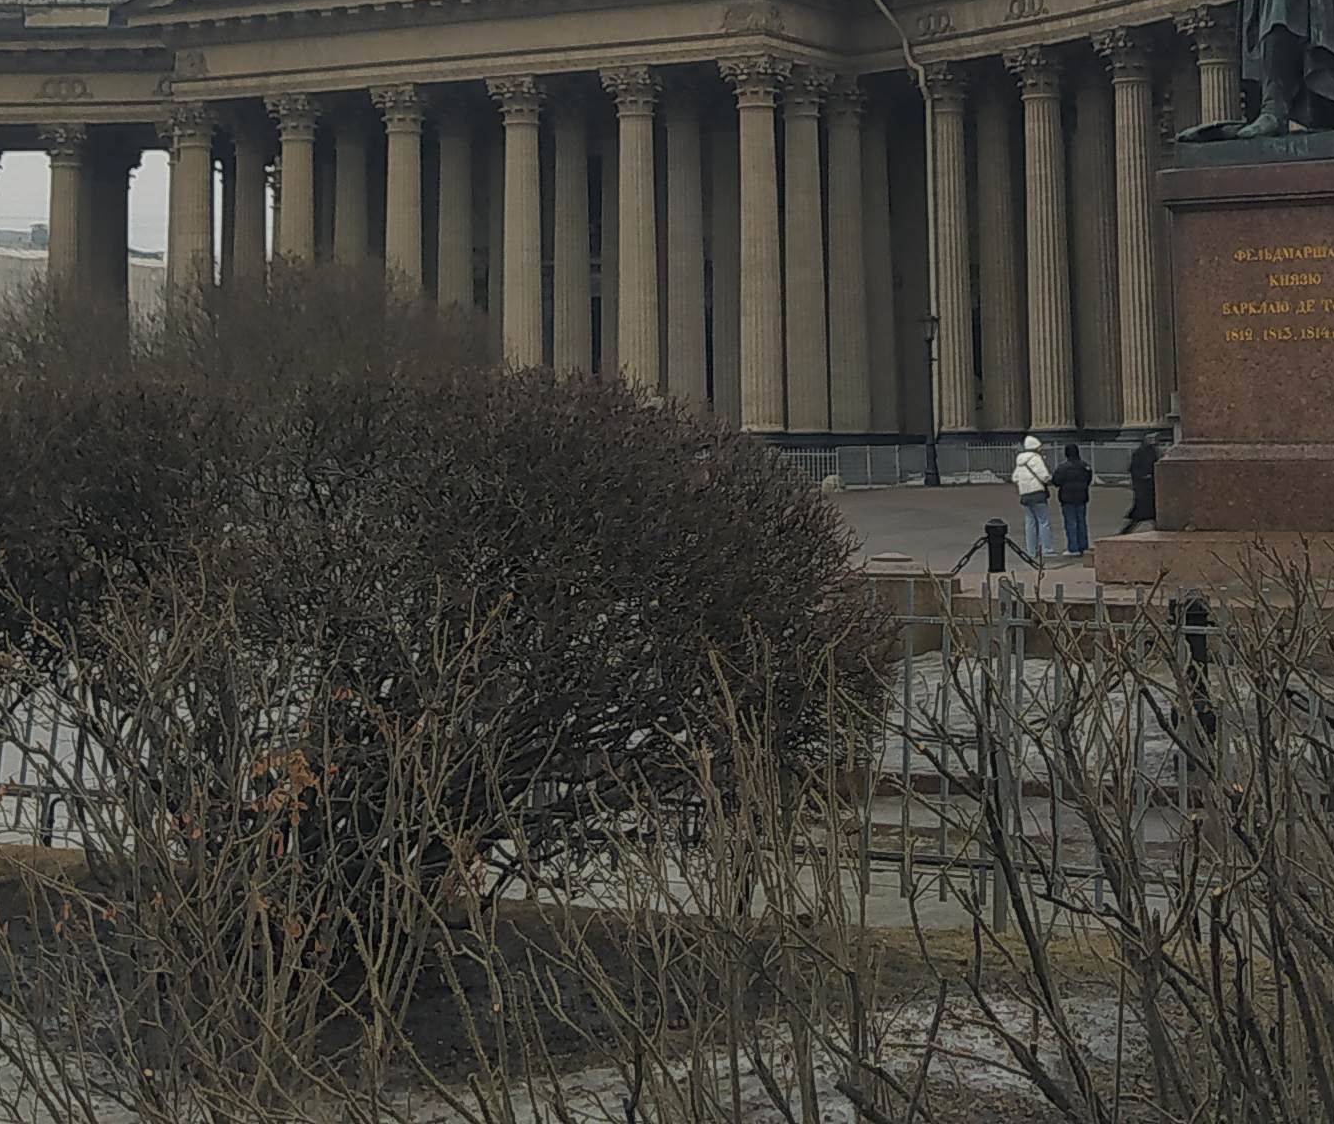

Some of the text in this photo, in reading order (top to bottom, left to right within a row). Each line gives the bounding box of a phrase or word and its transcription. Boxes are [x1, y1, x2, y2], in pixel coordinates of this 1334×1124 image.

[1269, 272, 1322, 287] КНЯЗЮ
[1222, 299, 1291, 316] БАРКЛАЮ
[1296, 298, 1316, 315] ДЕ
